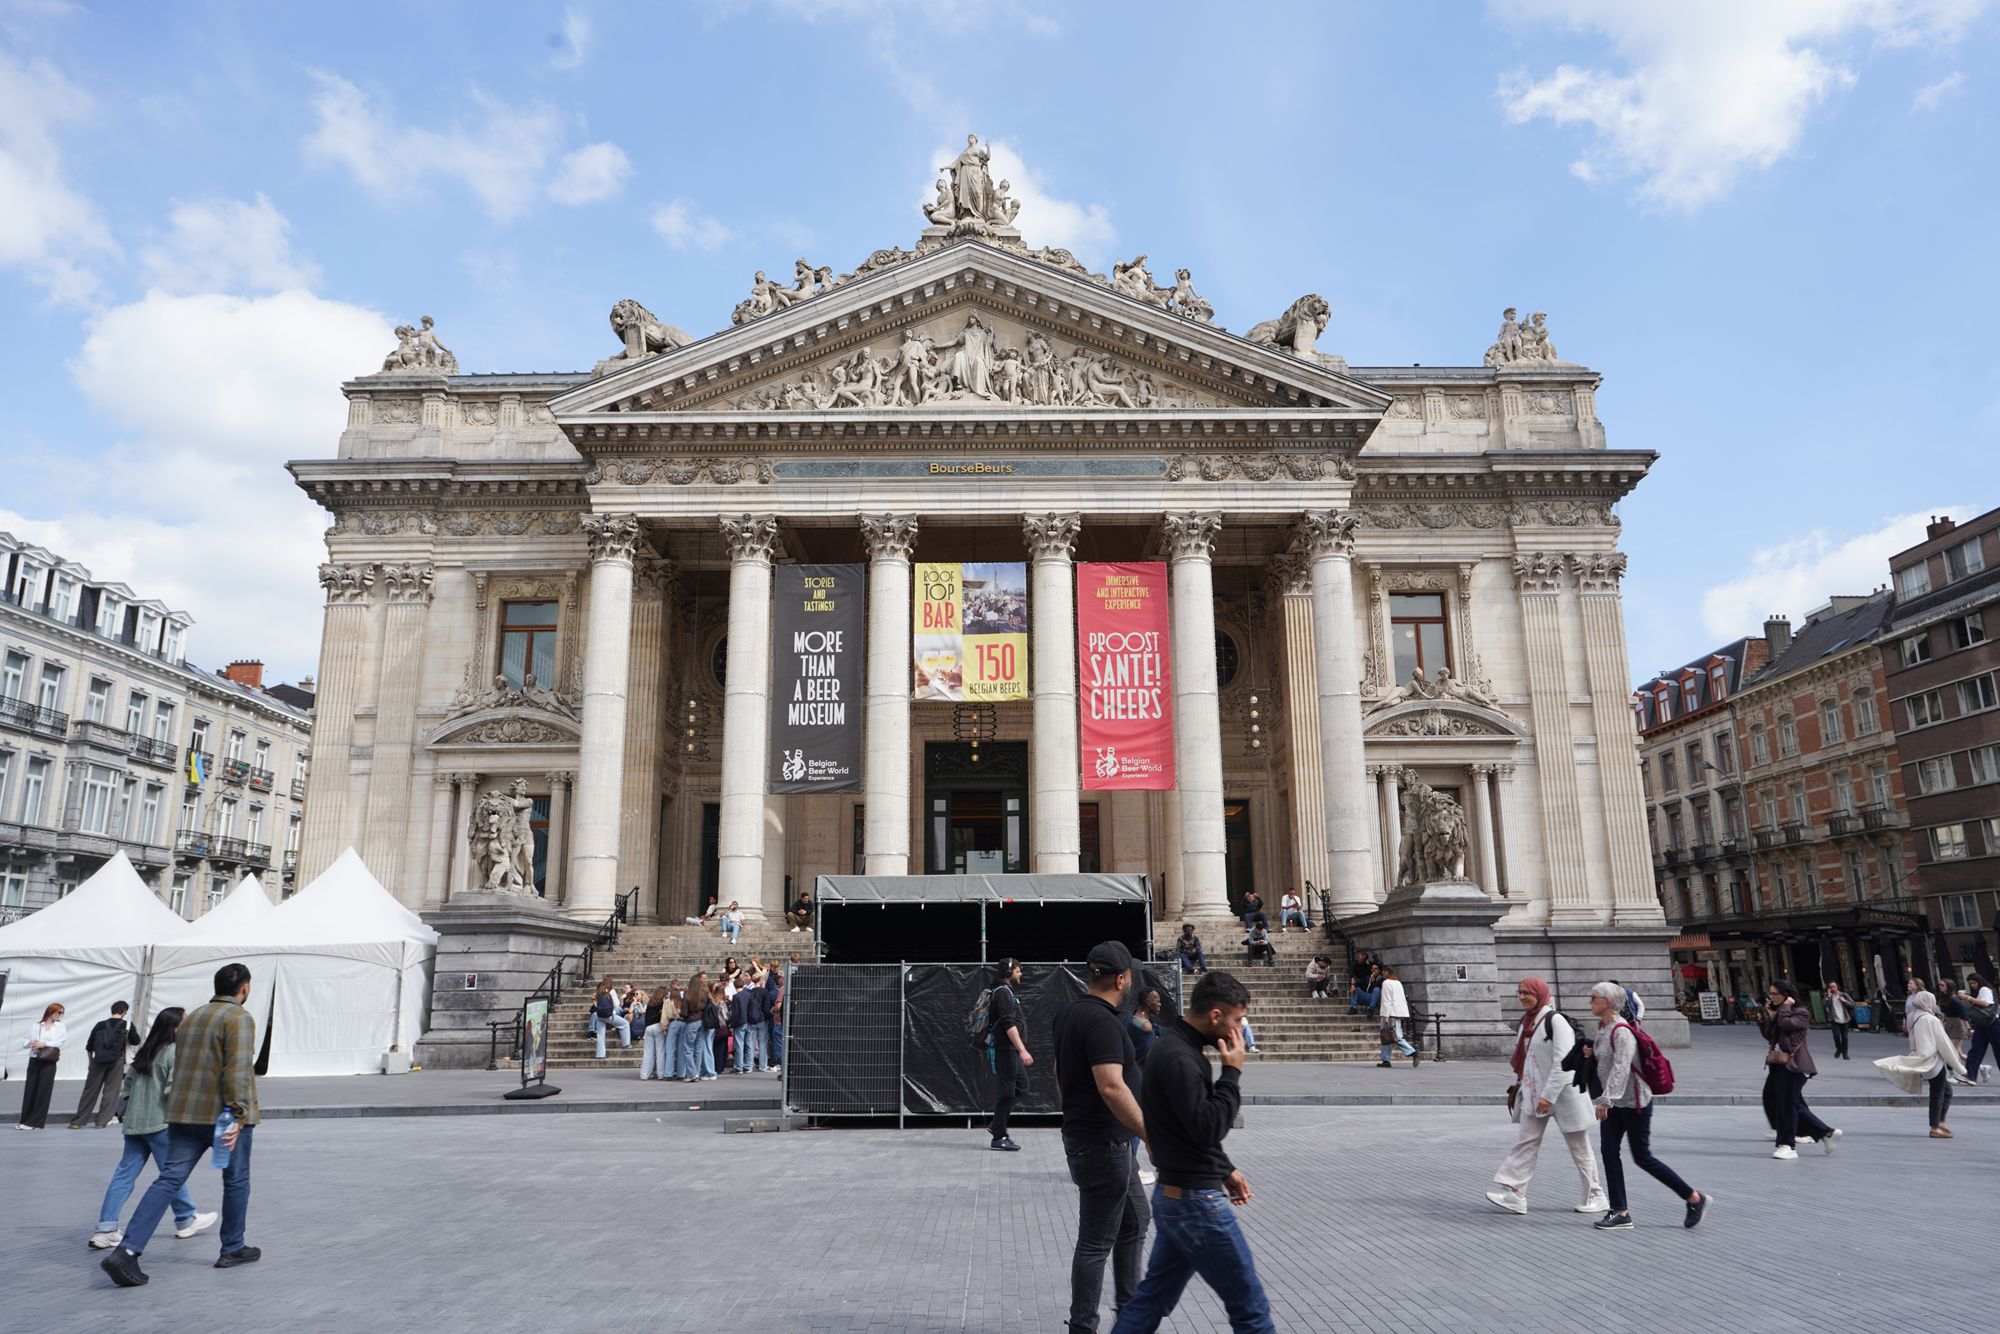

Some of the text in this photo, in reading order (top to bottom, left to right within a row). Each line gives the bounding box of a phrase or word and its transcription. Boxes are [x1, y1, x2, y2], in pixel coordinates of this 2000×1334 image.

[930, 463, 1013, 474] BourseBeurs
[924, 571, 954, 582] ROOF
[1106, 575, 1139, 586] IMMERSIVE
[813, 589, 825, 600] AND
[924, 583, 954, 600] TOP
[1097, 587, 1150, 598] AND INTERACTIVE
[804, 600, 835, 611] TASTINGS!
[1105, 599, 1142, 610] EXPERIENCE
[923, 602, 954, 628] BAR
[794, 631, 843, 653] MORE
[1089, 632, 1159, 653] PROOST
[800, 655, 835, 676] THAN
[975, 643, 1015, 681] 150
[1091, 651, 1161, 687] SANTÉ!
[794, 679, 840, 700] A BEER
[970, 682, 1021, 694] BELGIAN BEERS
[1091, 688, 1162, 720] CHEERS
[789, 703, 845, 725] MUSEUM
[808, 760, 837, 768] Belgian
[1122, 757, 1150, 765] Belgian
